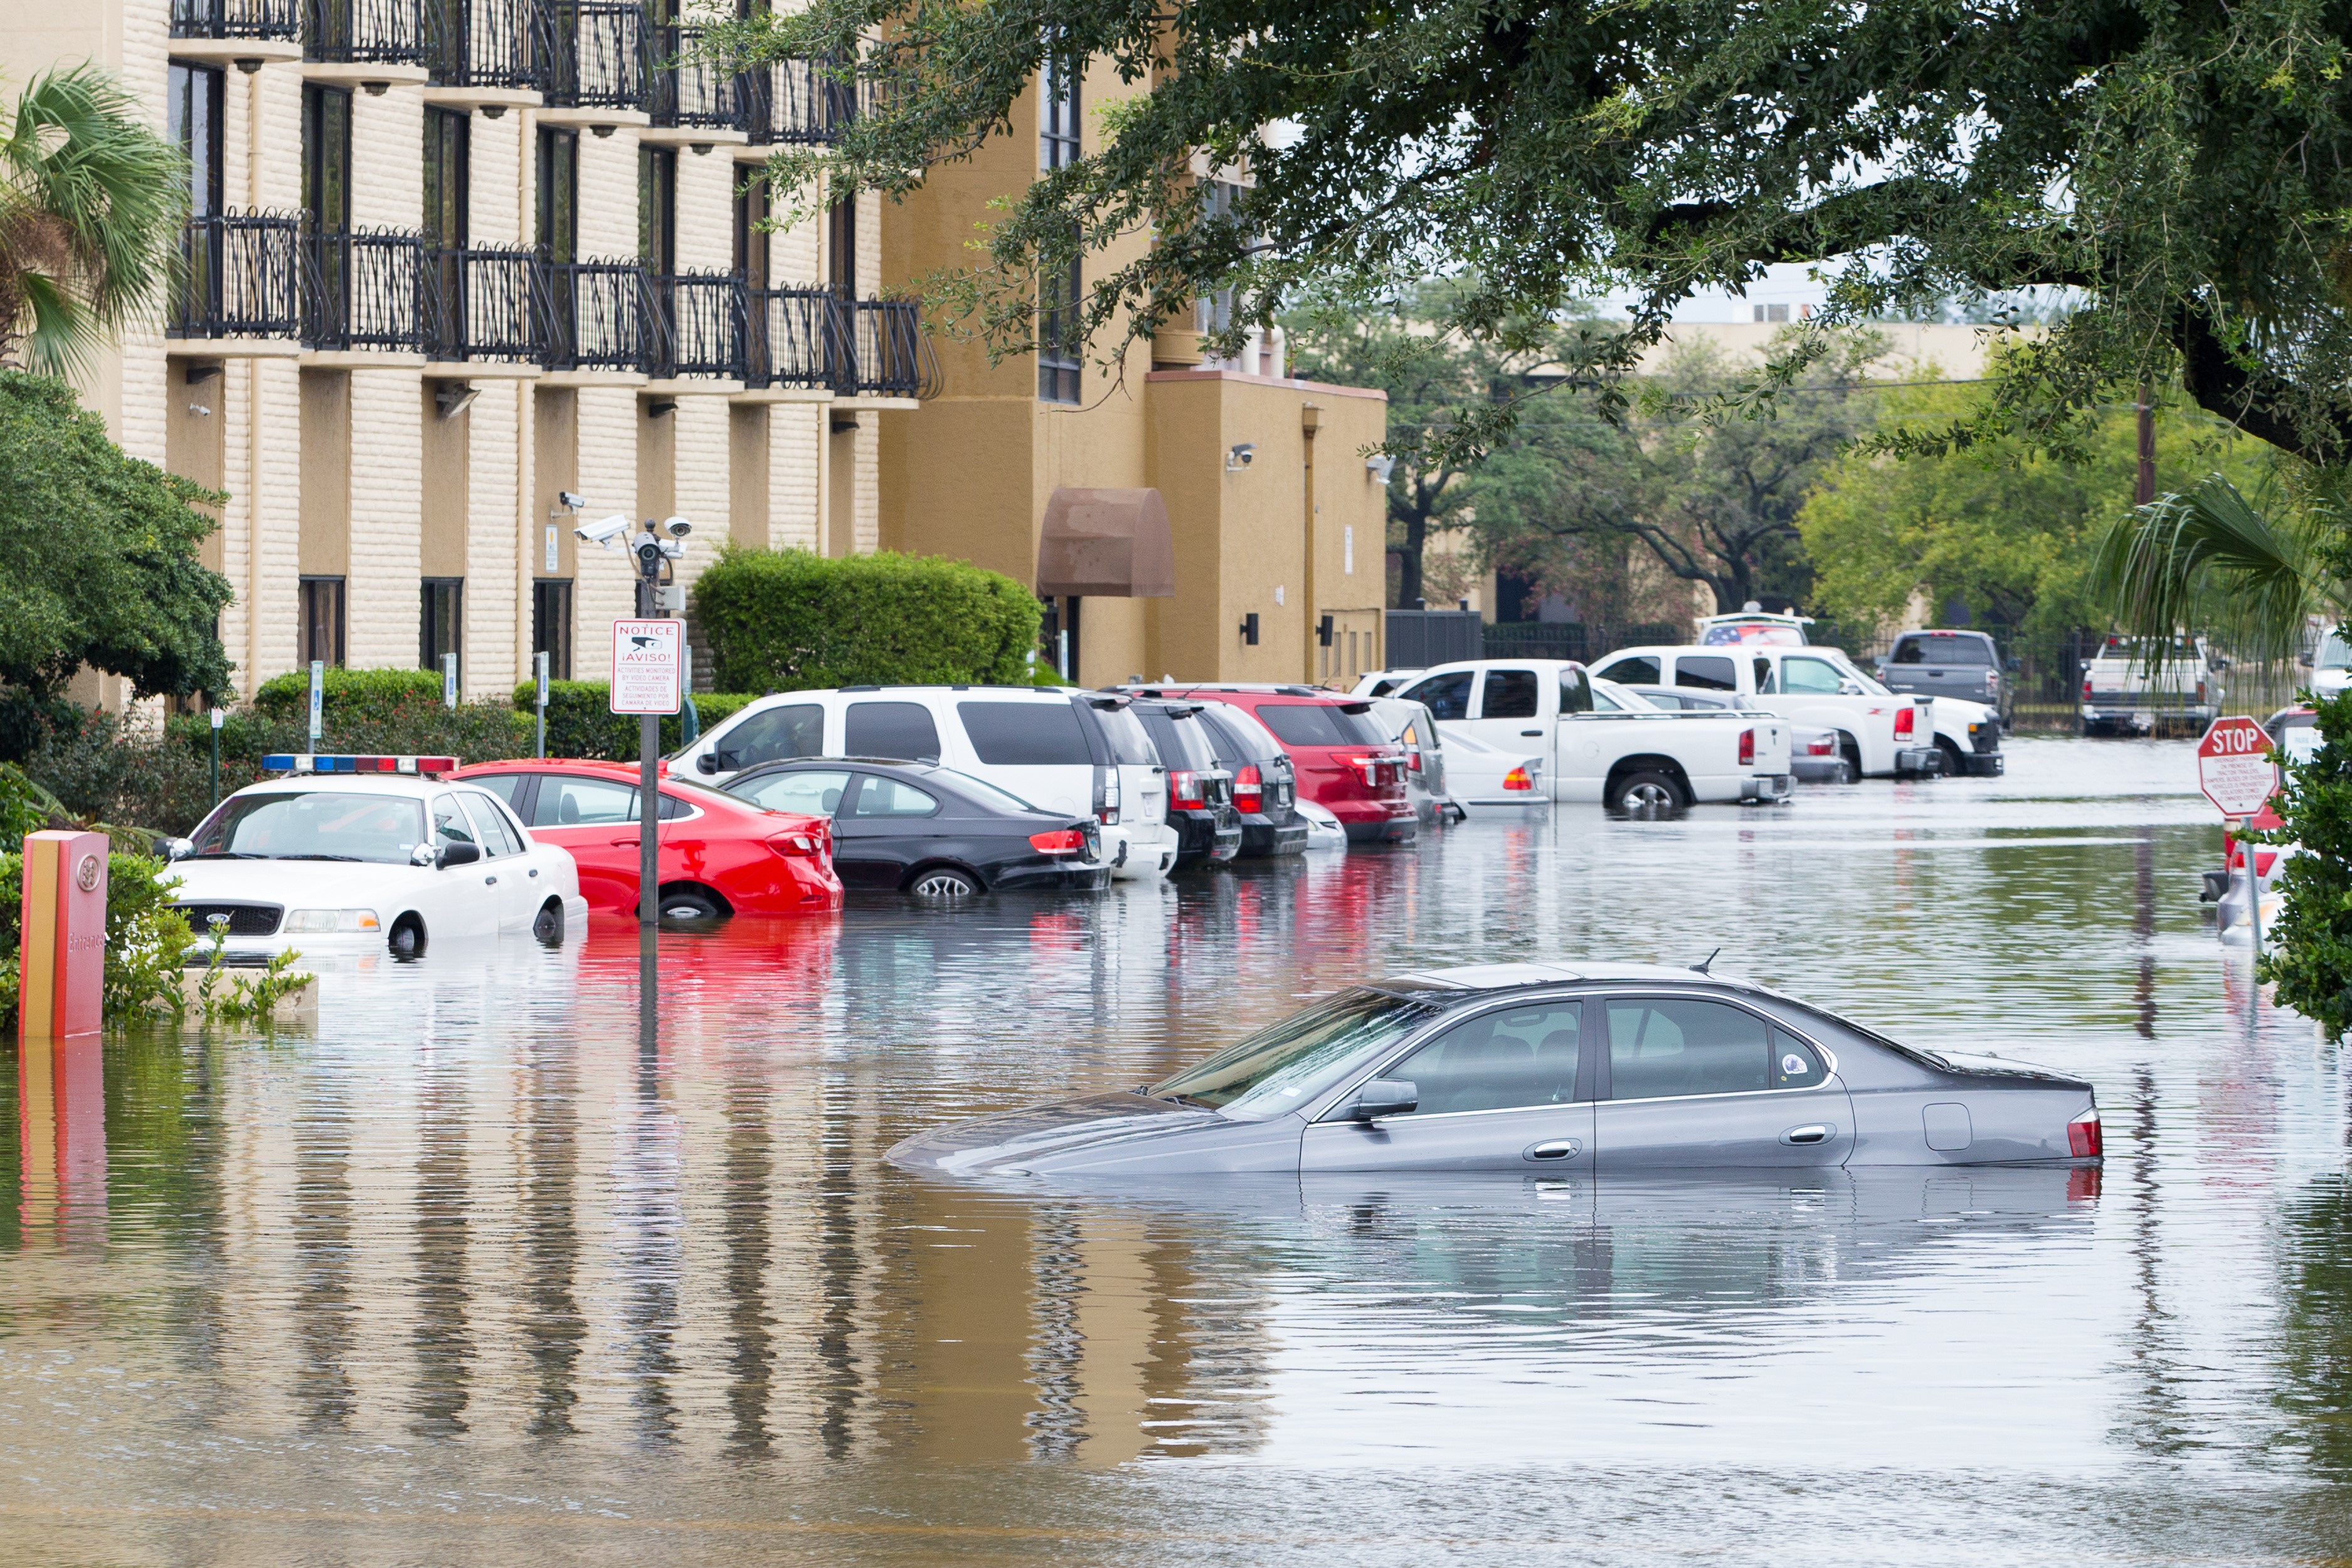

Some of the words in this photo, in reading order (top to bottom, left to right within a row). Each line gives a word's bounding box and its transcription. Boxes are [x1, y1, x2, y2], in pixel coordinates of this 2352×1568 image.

[620, 627, 674, 635] NOTICE
[622, 653, 670, 662] ¡AVISO!
[2212, 728, 2258, 753] STOP
[69, 933, 104, 953] Entrance
